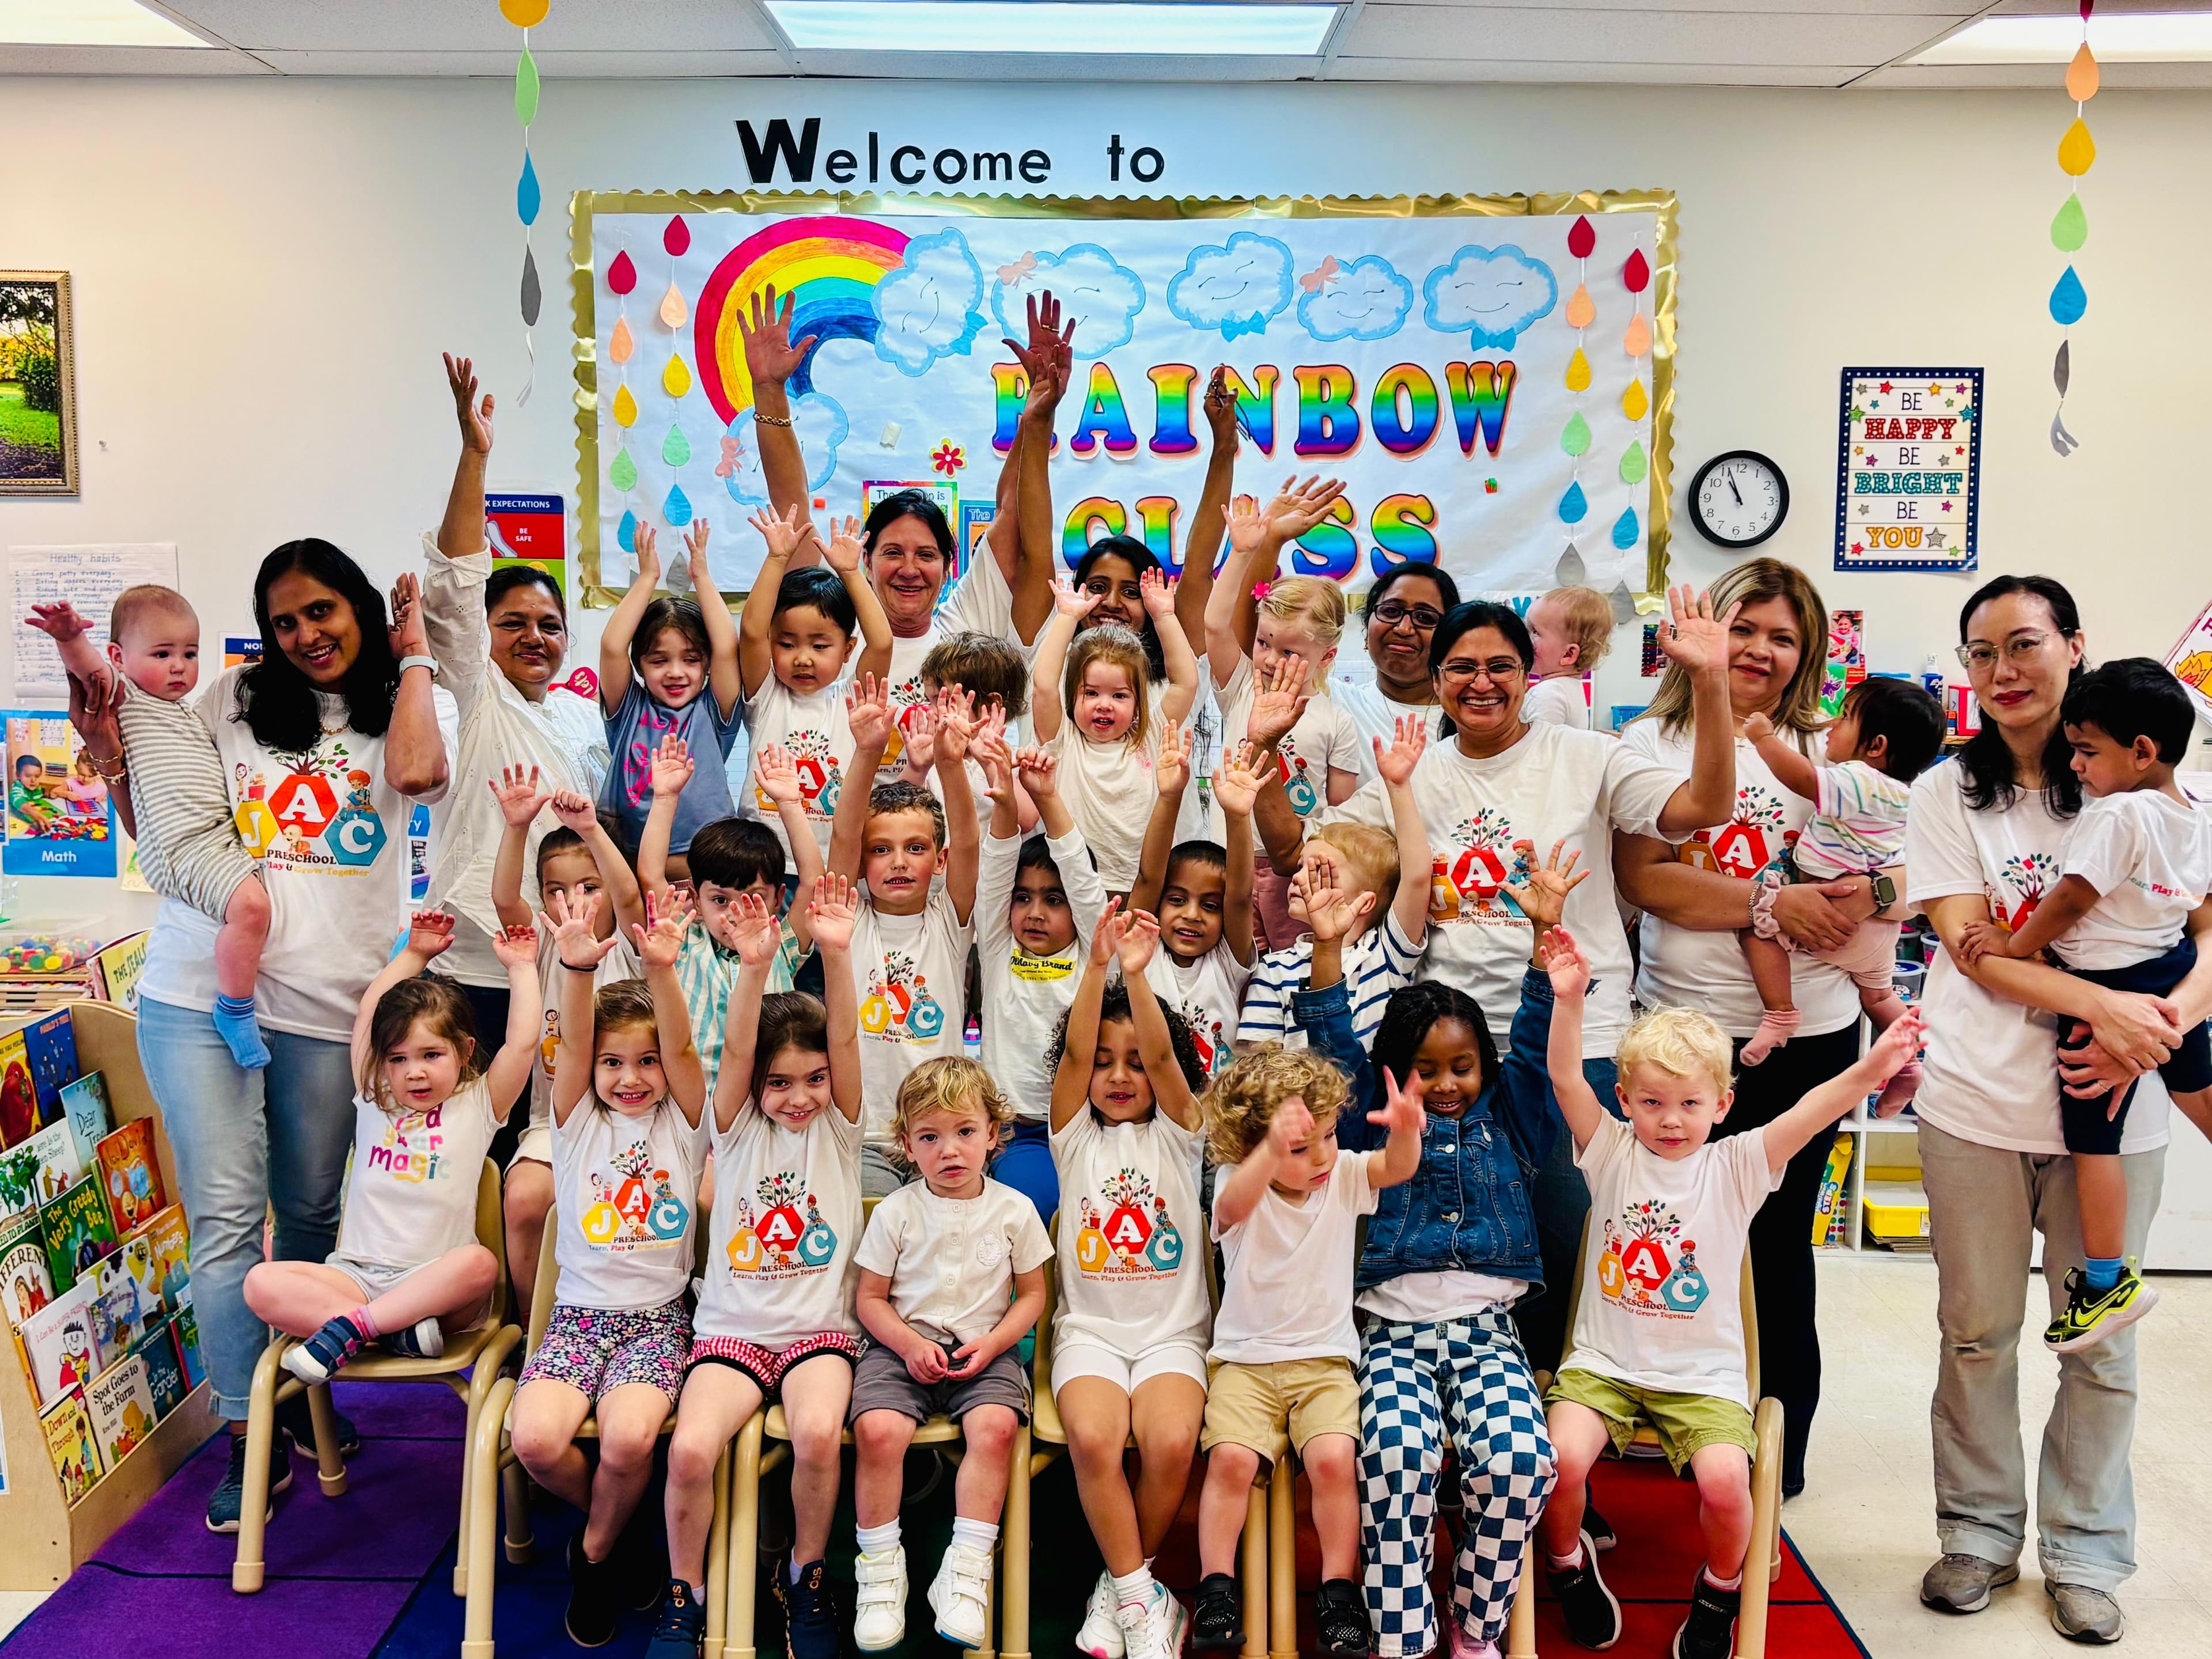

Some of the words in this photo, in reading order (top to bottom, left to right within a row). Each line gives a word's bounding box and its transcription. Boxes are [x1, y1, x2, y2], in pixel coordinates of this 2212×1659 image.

[735, 118, 1051, 184] Welcome
[1107, 134, 1165, 183] to
[991, 361, 1516, 454] RAINBOW
[1903, 393, 1922, 410] BE
[1865, 418, 1957, 440] HAPPY
[1899, 447, 1919, 465] BE
[1736, 464, 1747, 474] 12
[1710, 478, 1722, 488] 10
[1763, 480, 1771, 490] 2
[1854, 472, 1963, 494] BRIGHT
[876, 490, 893, 501] The
[938, 491, 945, 500] is
[1703, 493, 1711, 503] 9
[1767, 497, 1774, 506] 3
[492, 500, 551, 508] EXPECTATIONS
[1897, 501, 1918, 519] BE
[969, 509, 990, 520] The
[1706, 508, 1714, 518] 8
[1760, 512, 1768, 521] 4
[1718, 520, 1725, 529] 7
[1732, 526, 1740, 535] 6
[1748, 522, 1756, 532] 5
[1866, 527, 1923, 548] YOU
[50, 553, 82, 565] Healthy
[90, 552, 121, 562] habits
[242, 783, 375, 854] JAC
[41, 850, 77, 863] Math
[267, 849, 337, 865] PRESCHOOL
[294, 866, 323, 874] Grow
[326, 867, 370, 877] Together
[2152, 883, 2173, 896] Play
[1041, 960, 1073, 971] Brand
[76, 1110, 96, 1135] Dear
[369, 1145, 452, 1184] magic
[69, 1184, 99, 1218] Greedy
[47, 1205, 63, 1224] The
[591, 1185, 680, 1235] JAC
[85, 1210, 104, 1228] Bee
[49, 1215, 73, 1251] Very
[613, 1234, 661, 1244] PRESCHOOL
[736, 1213, 830, 1262] JAC
[1081, 1214, 1177, 1263] JAC
[800, 1266, 830, 1276] Together
[1103, 1266, 1156, 1274] PRESCHOOL
[1148, 1271, 1177, 1280] Together
[1602, 1247, 1699, 1303] JAC
[1660, 1312, 1695, 1320] Together
[92, 1384, 110, 1405] Spot
[110, 1370, 130, 1391] Goes
[130, 1364, 139, 1377] to
[102, 1400, 115, 1416] the
[114, 1385, 136, 1407] Farm
[48, 1412, 69, 1436] Down
